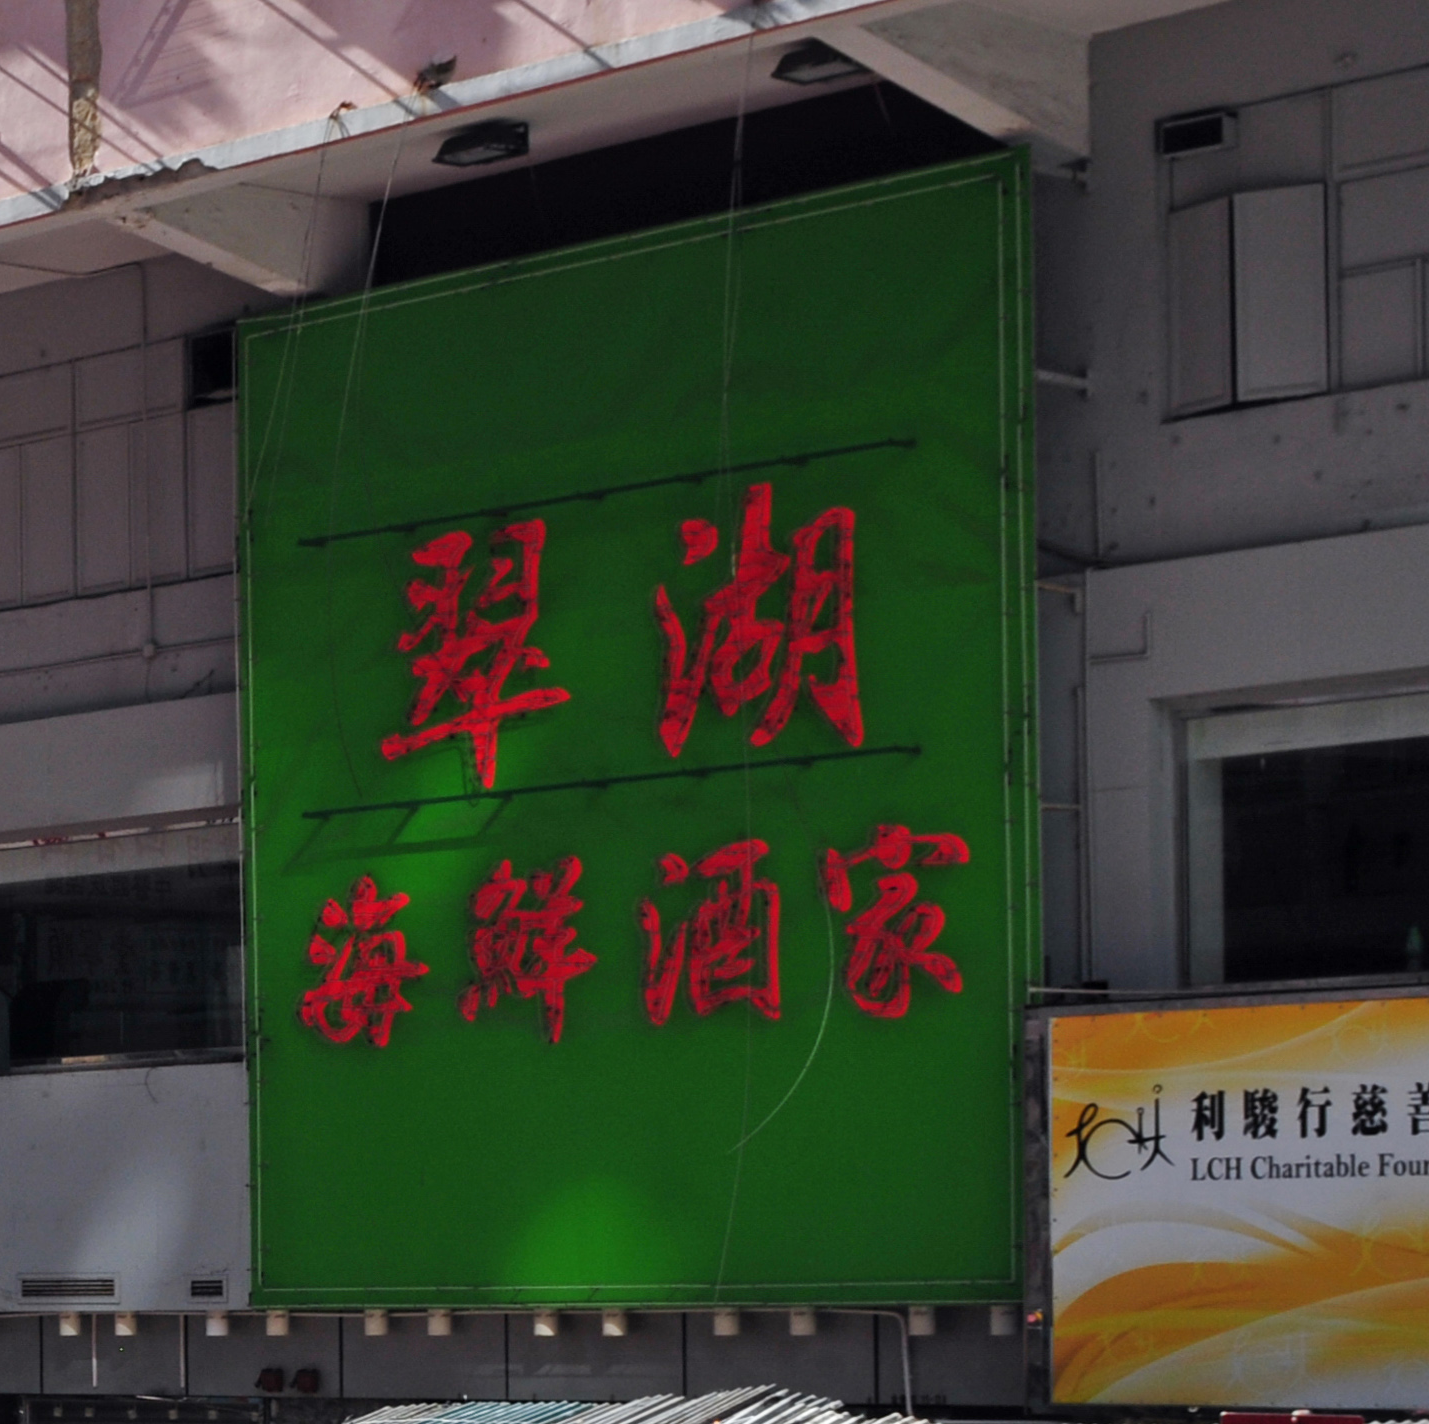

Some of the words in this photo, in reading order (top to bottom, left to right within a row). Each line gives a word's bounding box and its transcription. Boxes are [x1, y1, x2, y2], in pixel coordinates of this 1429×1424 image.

[381, 481, 866, 789] 翠湖
[299, 824, 970, 1047] 海鮮酒家
[1191, 1157, 1242, 1180] LCH
[1250, 1154, 1370, 1180] Charitable
